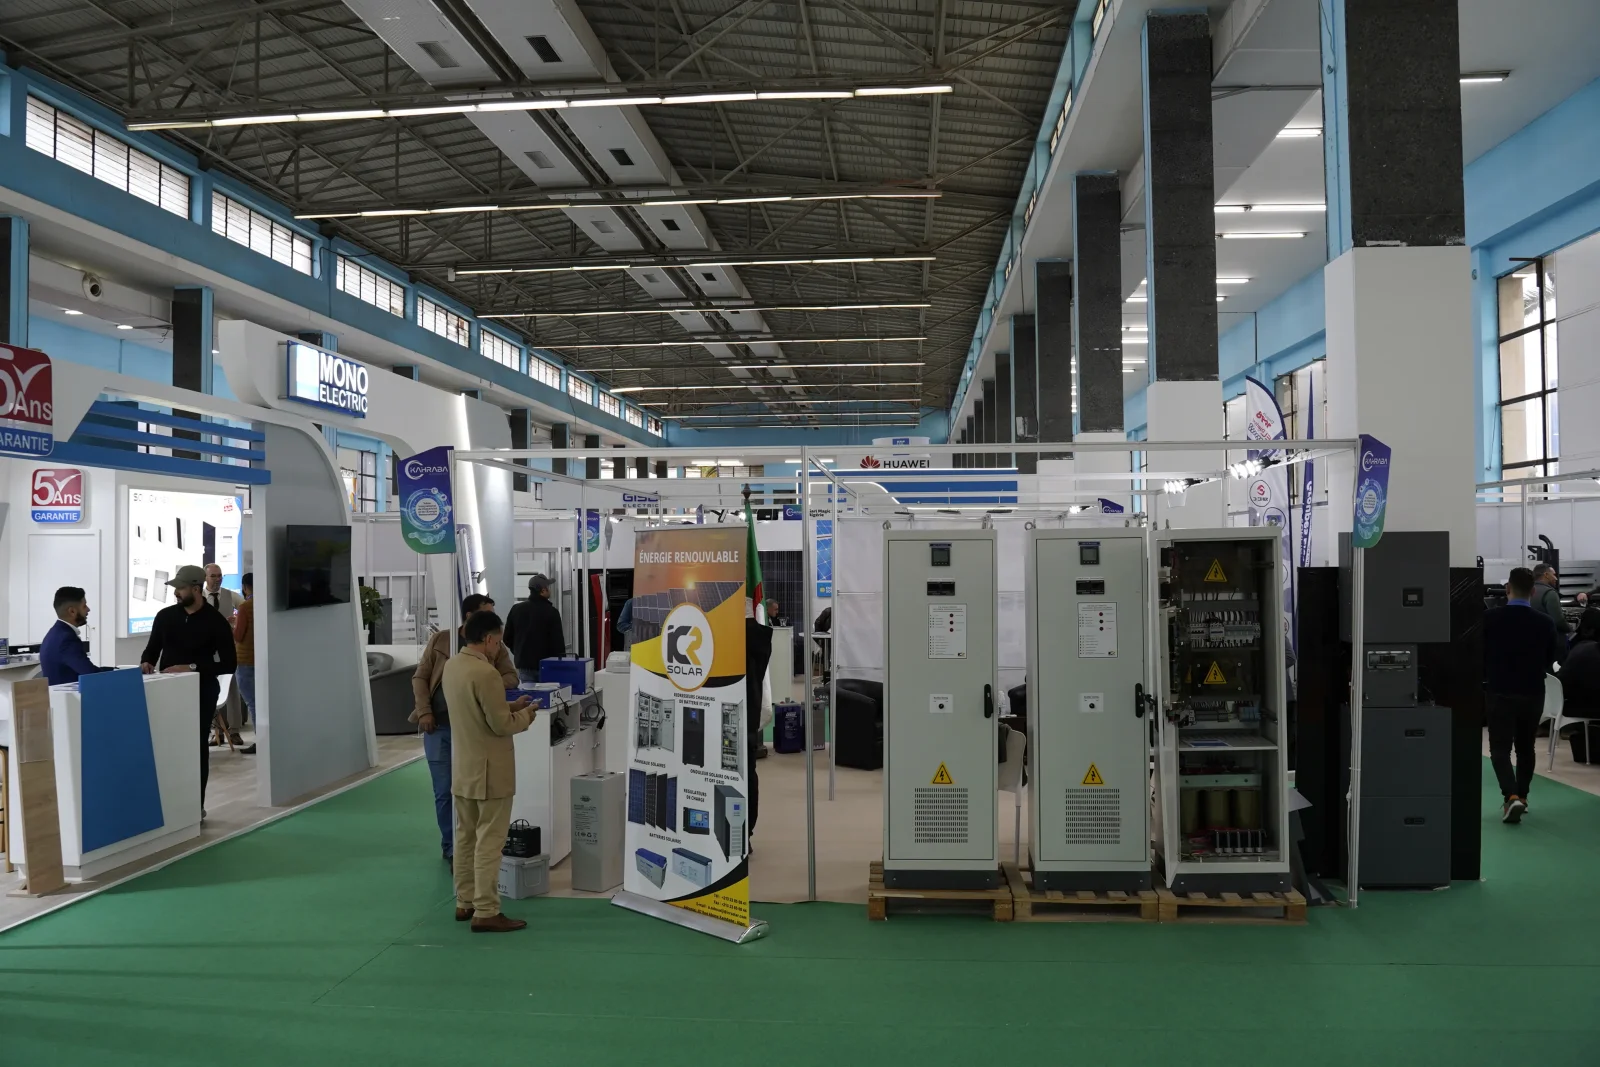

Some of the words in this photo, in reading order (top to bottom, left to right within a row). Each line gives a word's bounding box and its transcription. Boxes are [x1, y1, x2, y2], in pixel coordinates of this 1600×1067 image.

[320, 352, 369, 395] MONO
[13, 390, 52, 420] Ans
[320, 384, 368, 413] ELECTRIC
[883, 459, 930, 468] HUAWEI
[33, 470, 55, 506] 5
[52, 490, 82, 504] Ans
[34, 512, 78, 520] GARANTIE
[640, 550, 672, 564] ÉNERGIE
[674, 550, 739, 563] RENOUVLABLE
[666, 665, 703, 676] SOLAR
